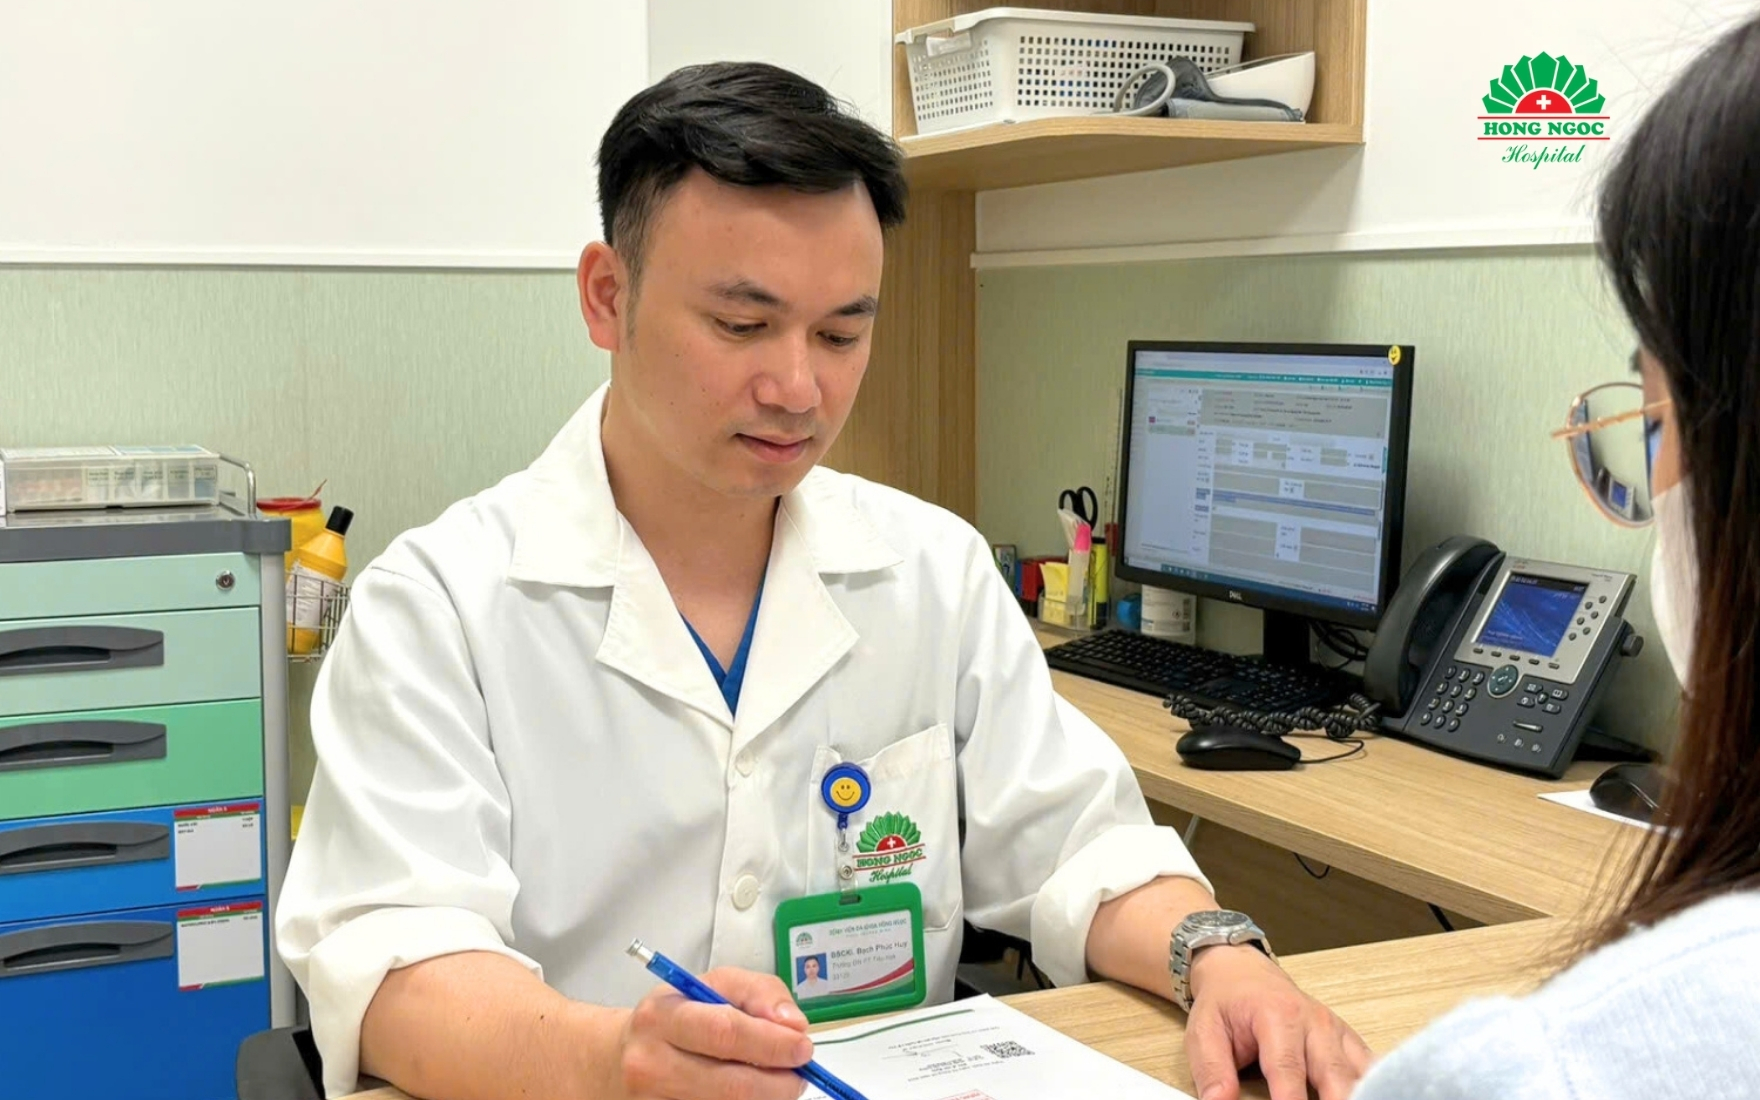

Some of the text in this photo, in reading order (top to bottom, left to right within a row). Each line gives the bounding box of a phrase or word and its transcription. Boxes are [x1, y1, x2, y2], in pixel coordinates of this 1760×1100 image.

[856, 848, 923, 868] HONG NGOC
[869, 863, 914, 883] Hospital
